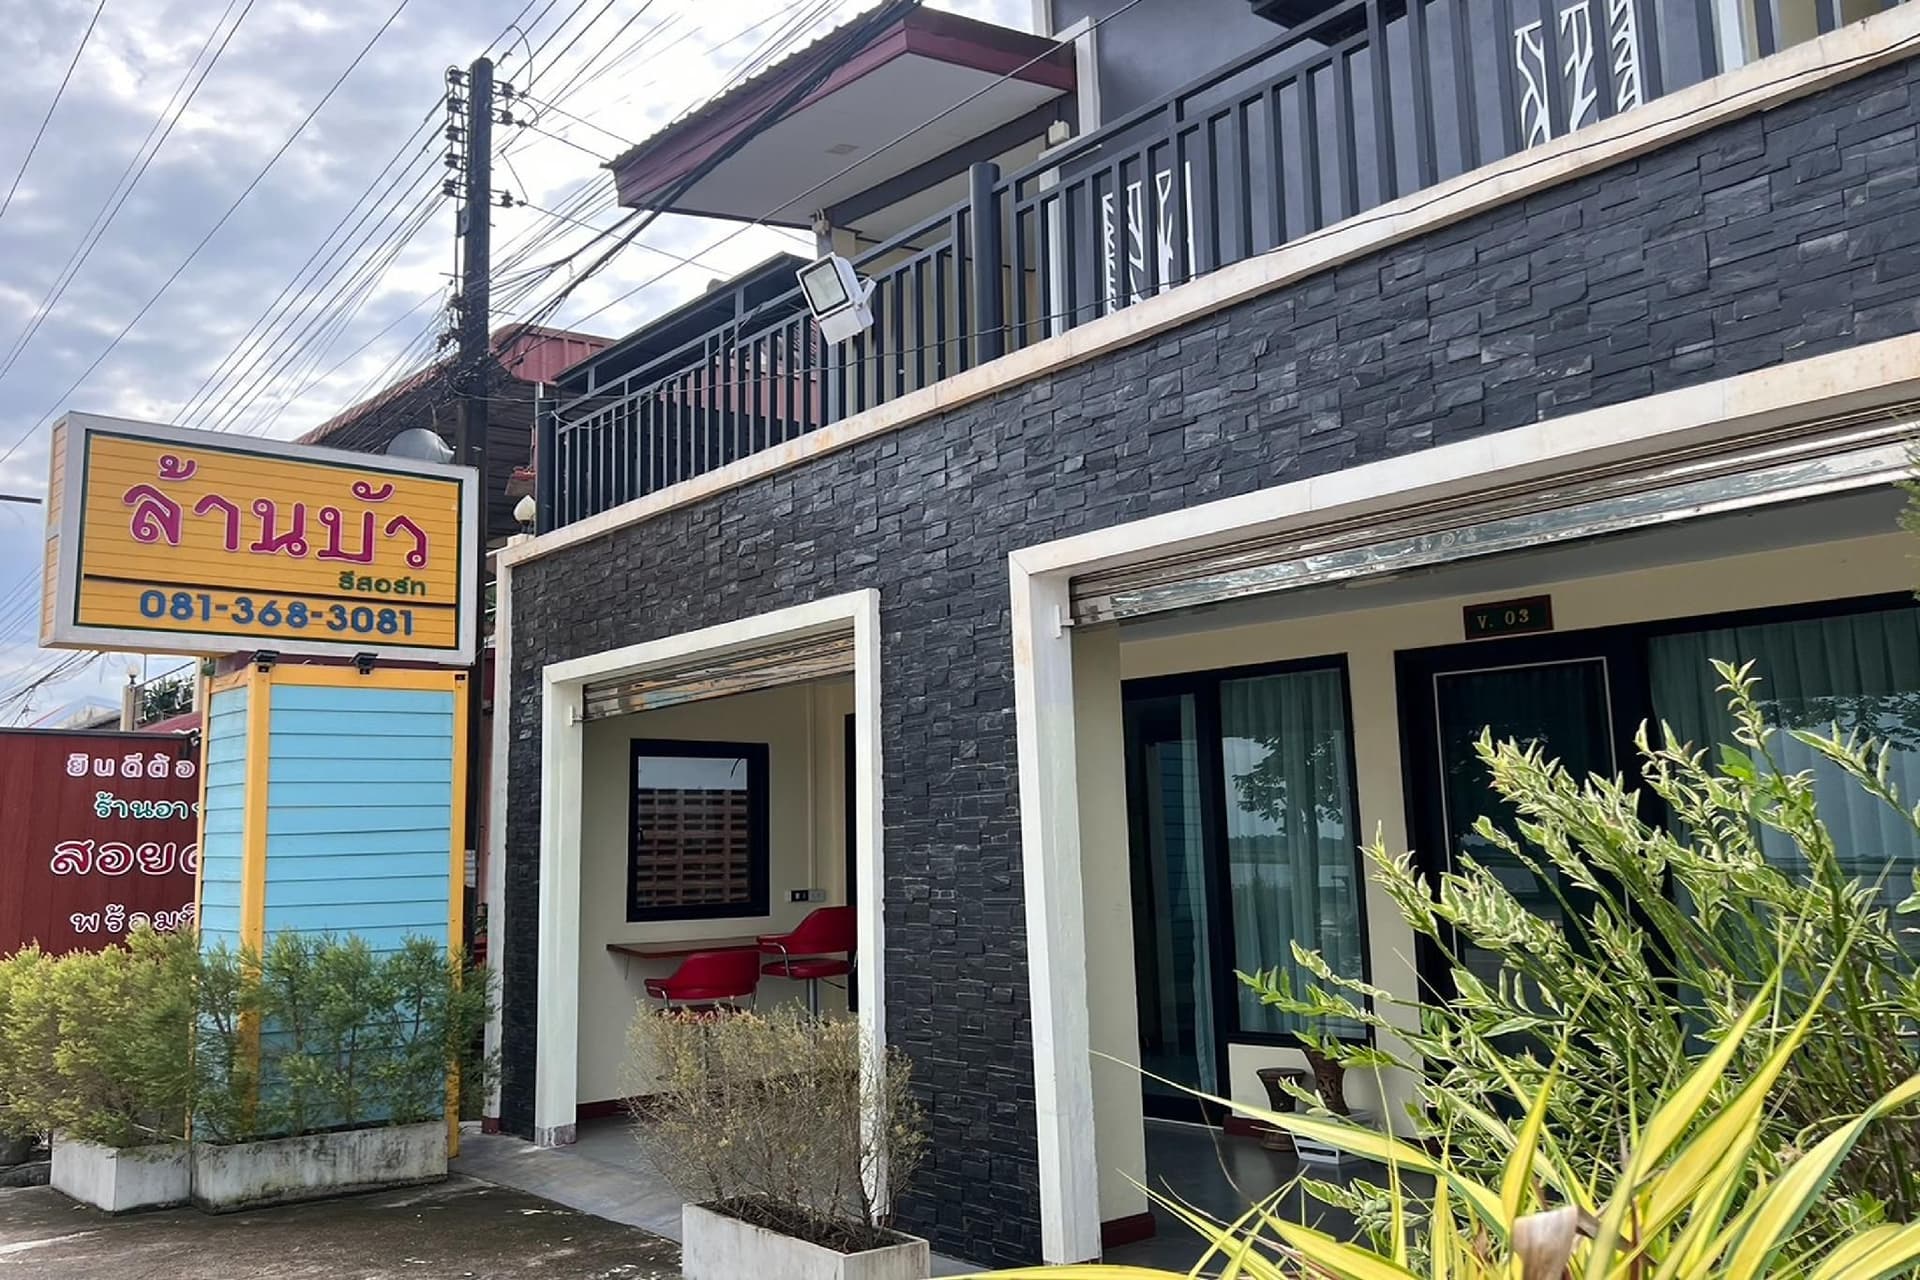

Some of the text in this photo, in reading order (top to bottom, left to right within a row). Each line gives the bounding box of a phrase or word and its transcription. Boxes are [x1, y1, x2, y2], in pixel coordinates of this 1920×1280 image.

[122, 454, 430, 570] ล้านบัว
[338, 570, 427, 597] รีสอร์ท
[139, 589, 414, 637] 081-368-3081
[1504, 608, 1530, 626] 03
